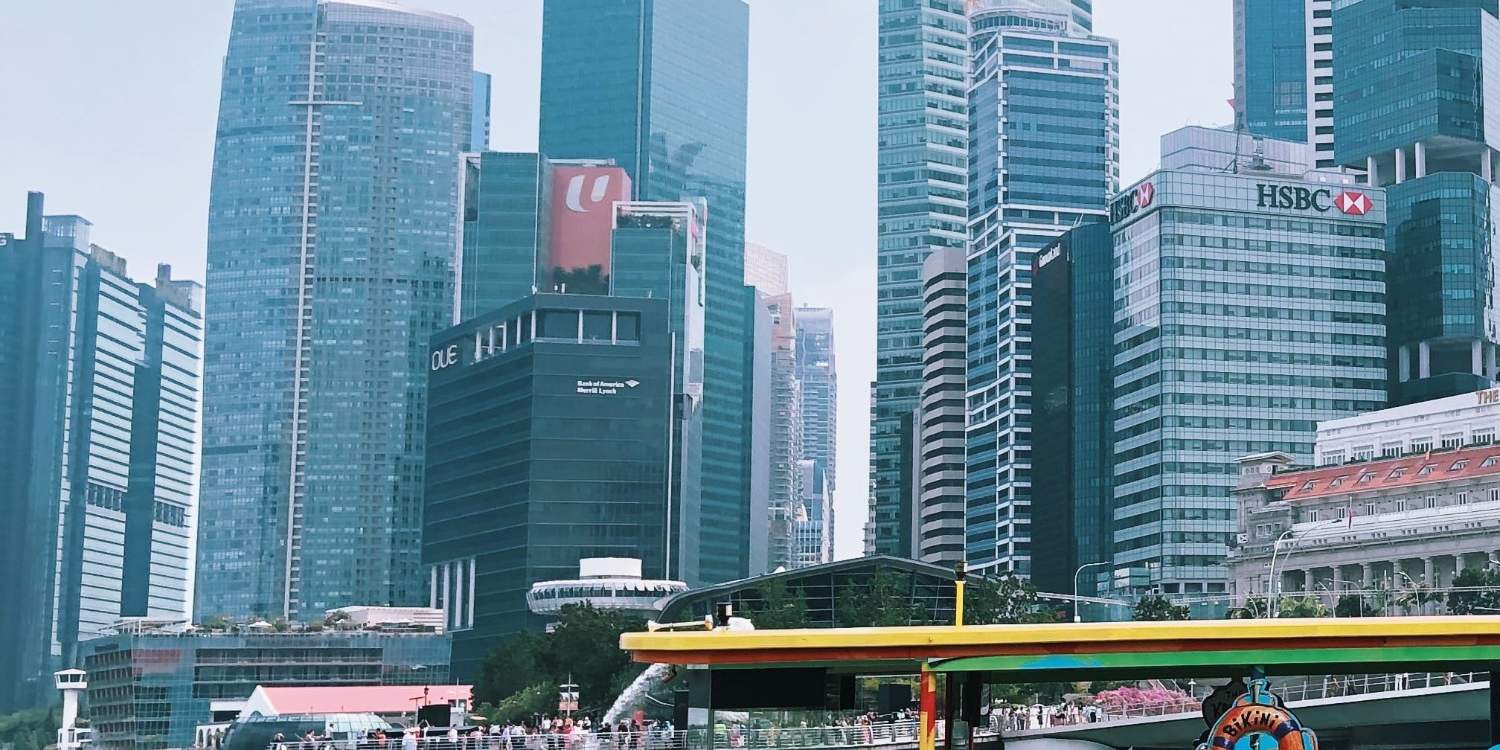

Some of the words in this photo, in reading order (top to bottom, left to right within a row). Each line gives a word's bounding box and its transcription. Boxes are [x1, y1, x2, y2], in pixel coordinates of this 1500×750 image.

[1256, 183, 1331, 212] HSBC
[431, 344, 457, 371] OUE
[599, 387, 617, 395] Lynch
[600, 380, 625, 388] America
[1476, 389, 1499, 404] THE
